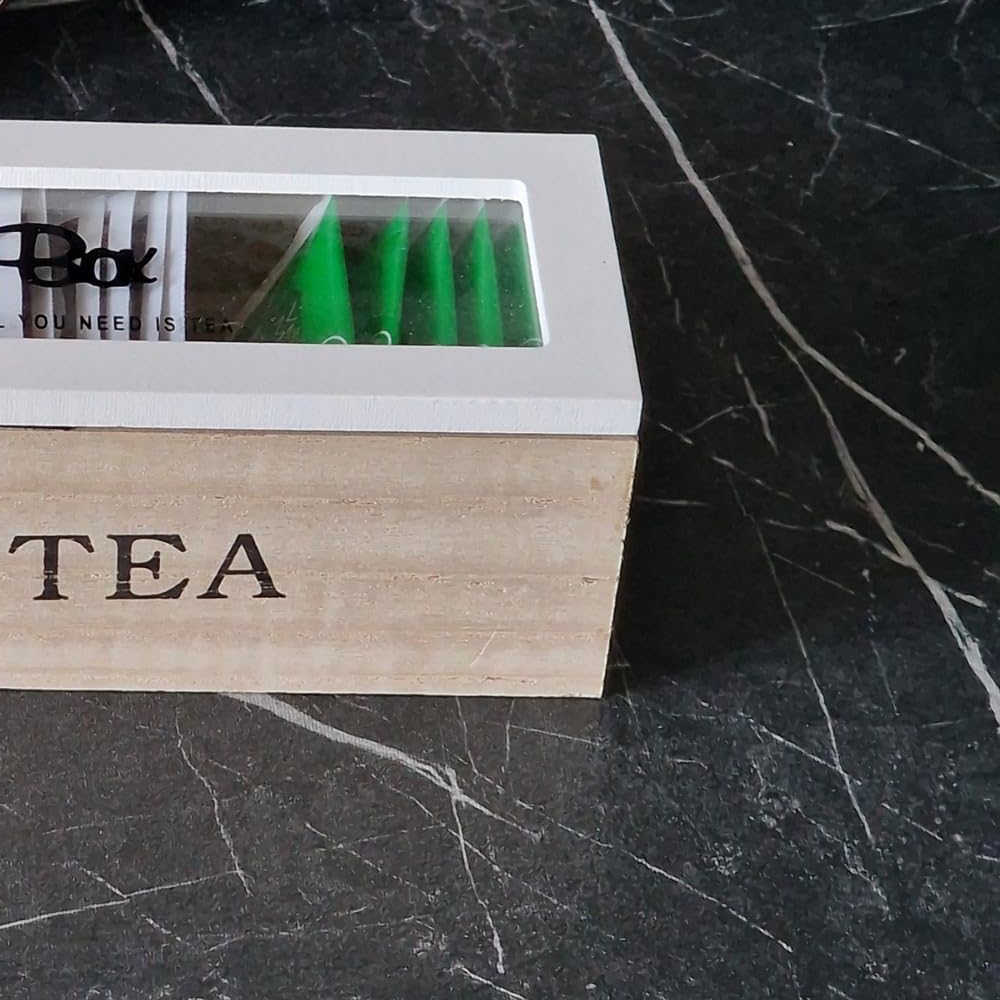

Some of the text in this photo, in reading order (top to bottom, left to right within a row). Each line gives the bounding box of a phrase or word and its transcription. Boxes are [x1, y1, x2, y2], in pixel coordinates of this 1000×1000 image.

[18, 314, 66, 330] YOU
[80, 315, 142, 331] NEED
[156, 317, 176, 332] IS
[192, 317, 234, 333] TEA
[9, 532, 286, 600] TEA
